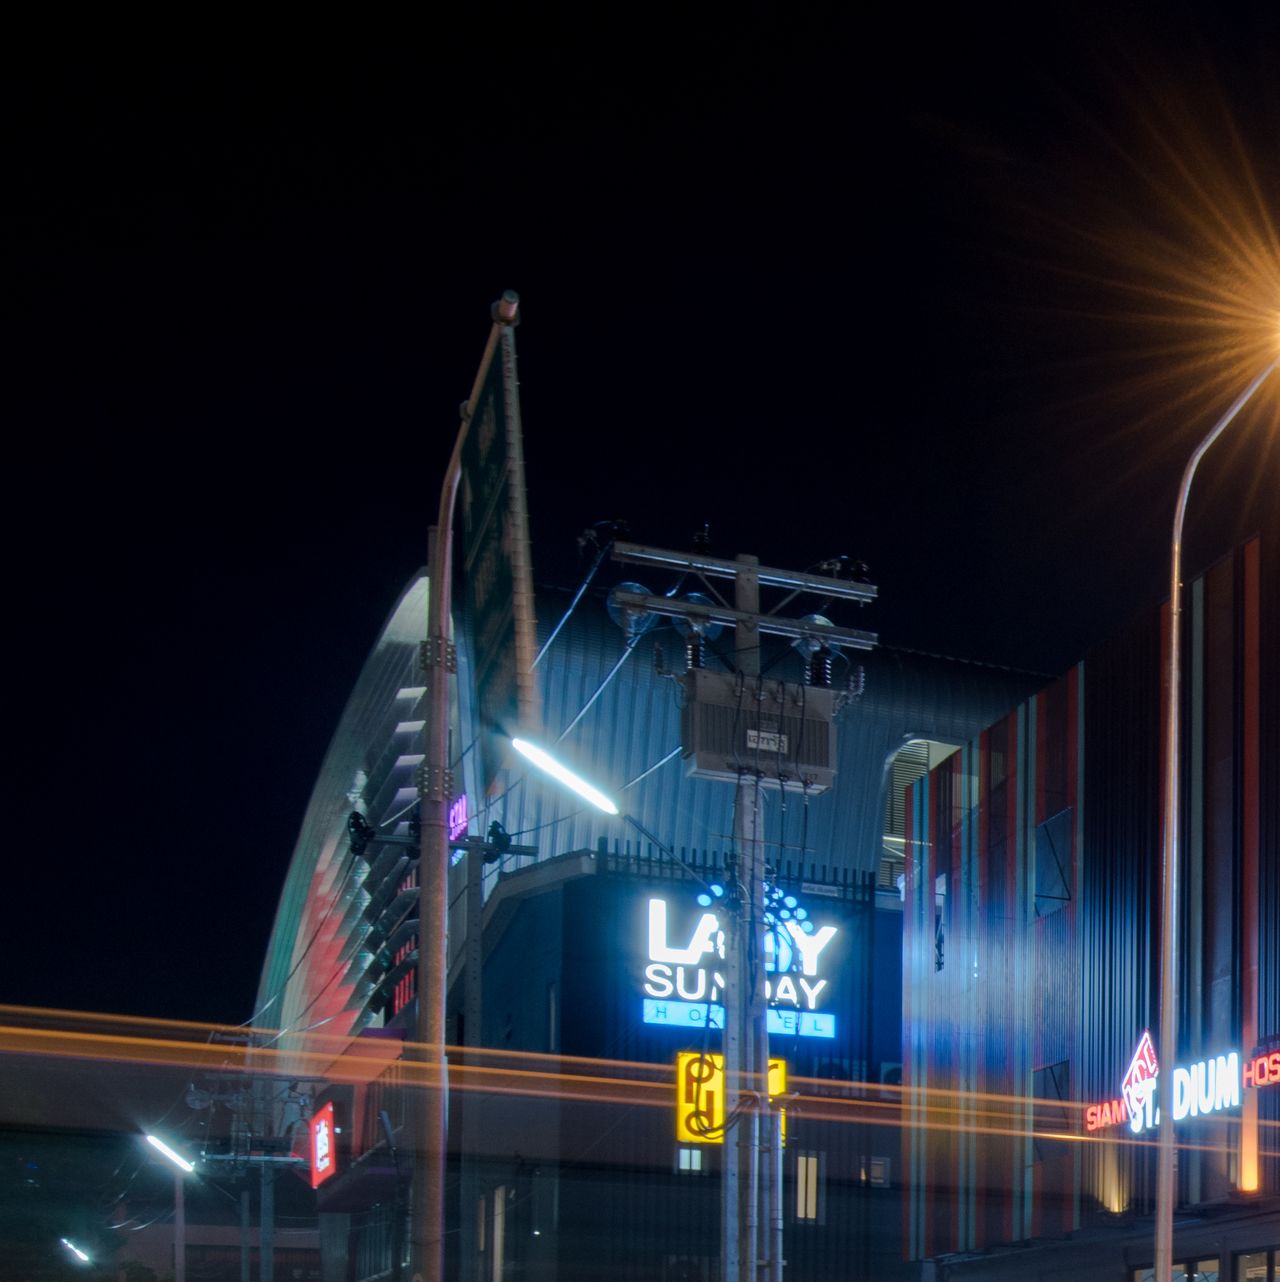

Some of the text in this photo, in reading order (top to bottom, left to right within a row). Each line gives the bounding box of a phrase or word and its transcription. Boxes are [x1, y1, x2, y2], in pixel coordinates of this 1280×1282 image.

[655, 1006, 824, 1033] HOEL
[1086, 1099, 1127, 1132] SIAM
[1130, 1052, 1240, 1134] STDIUM
